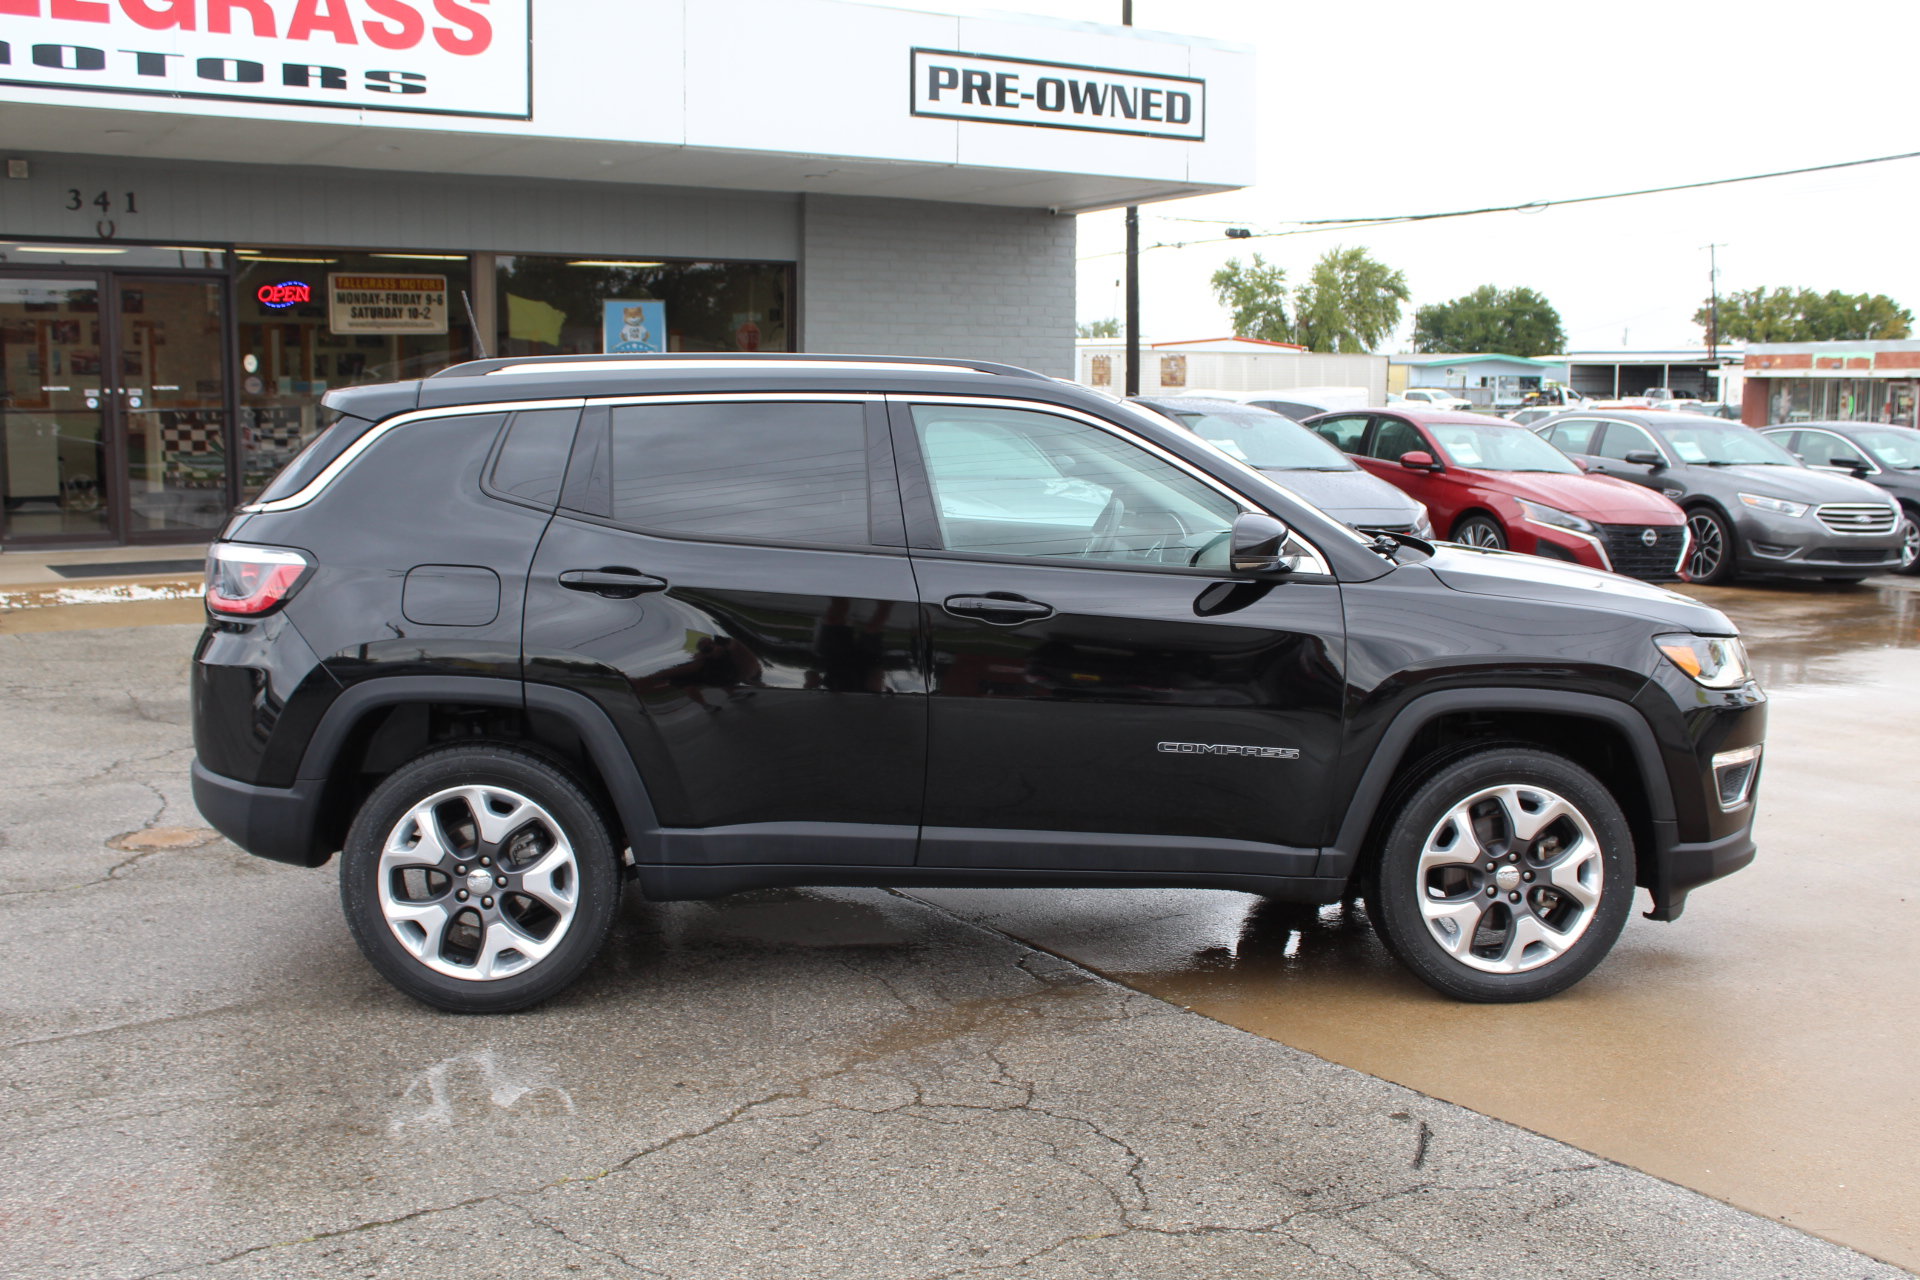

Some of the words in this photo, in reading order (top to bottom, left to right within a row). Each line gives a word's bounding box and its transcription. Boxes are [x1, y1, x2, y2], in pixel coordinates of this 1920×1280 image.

[0, 40, 427, 95] OTORS
[928, 64, 1192, 125] PRE-OWNED
[65, 188, 138, 214] 341
[338, 277, 396, 290] TALLGRASS
[399, 279, 443, 291] MOTORS
[258, 285, 310, 303] OPEN
[336, 292, 421, 305] MONDAY-FRIDAY
[350, 306, 402, 319] SATURDAY
[407, 307, 431, 319] 10-2
[1157, 741, 1300, 760] COMPASS
